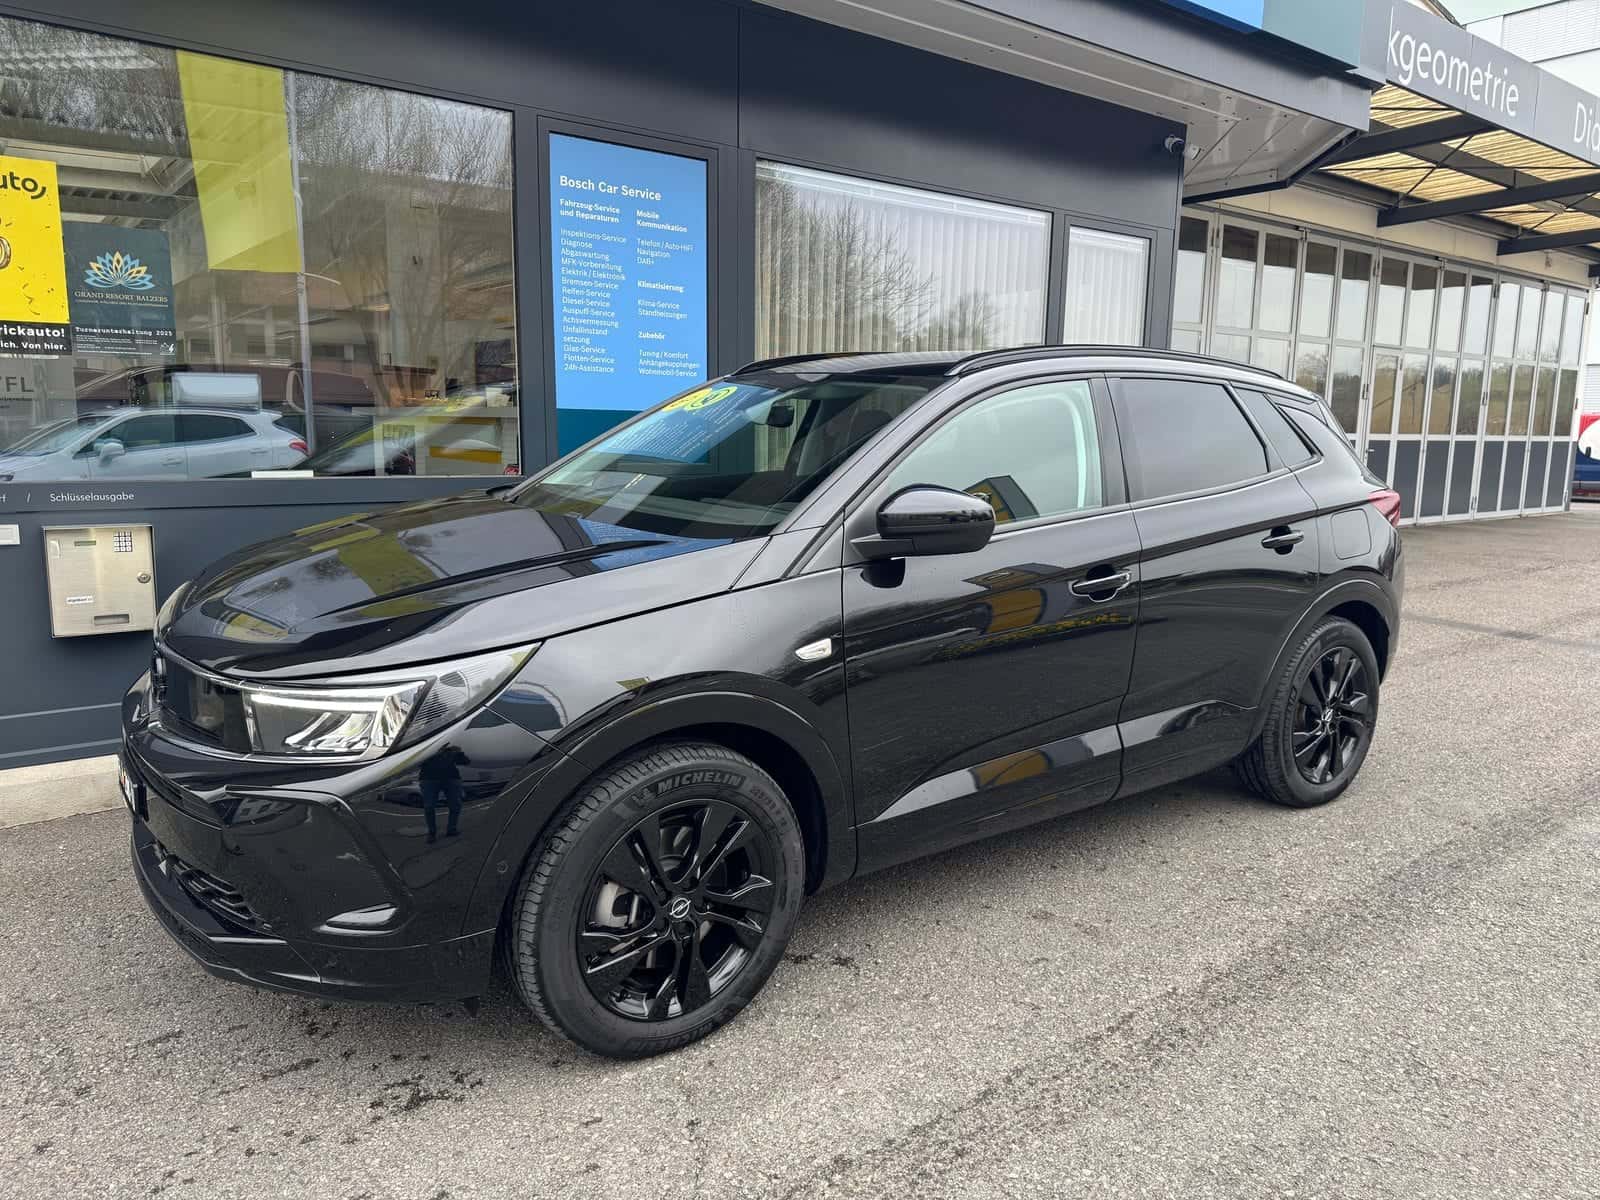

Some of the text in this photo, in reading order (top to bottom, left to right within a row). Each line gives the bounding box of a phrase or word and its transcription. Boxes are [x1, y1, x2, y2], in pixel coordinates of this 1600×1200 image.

[560, 175, 662, 200] Bosch Car Service
[560, 199, 620, 214] Fahrzeug-Service
[560, 209, 619, 223] und Reparaturen
[636, 210, 660, 219] Mobile
[636, 220, 688, 232] Kommunikation
[561, 228, 626, 243] Inspektions-Service
[561, 238, 593, 249] Diagnose
[637, 239, 660, 248] Telefon
[561, 248, 610, 261] Abgaswartung
[637, 248, 671, 259] Navigation
[561, 258, 623, 271] MFK-Vorbereitung
[637, 257, 655, 265] DAB+
[562, 267, 588, 276] Elektrik
[592, 270, 626, 280] Elektronik
[562, 277, 619, 289] Bremsen-Service
[638, 280, 684, 292] Klimatisierung
[106, 293, 135, 301] RESORT
[562, 287, 611, 298] Reifen-Service
[562, 297, 610, 307] Diesel-Service
[638, 300, 681, 310] Klima-Service
[563, 306, 616, 318] Auspuff-Service
[639, 309, 688, 320] Standheizungen
[563, 316, 619, 328] Achsvermessung
[75, 326, 152, 337] Turnerunterhaltung
[563, 326, 608, 336] Unfallinstand
[638, 331, 665, 340] Zubehör
[21, 341, 41, 350] Von
[43, 342, 67, 351] hier.
[563, 336, 591, 345] setzung
[564, 345, 606, 354] Glas-Service
[640, 350, 660, 359] Tuning
[664, 351, 689, 360] Komfort
[564, 354, 615, 364] Flotten-Service
[639, 359, 699, 370] Anhängekupplungen
[564, 363, 615, 374] 24h-Assistance
[639, 368, 697, 377] Wohnmobil-Service
[50, 491, 134, 503] Schlüsselausgabe
[657, 772, 741, 793] MICHELIN
